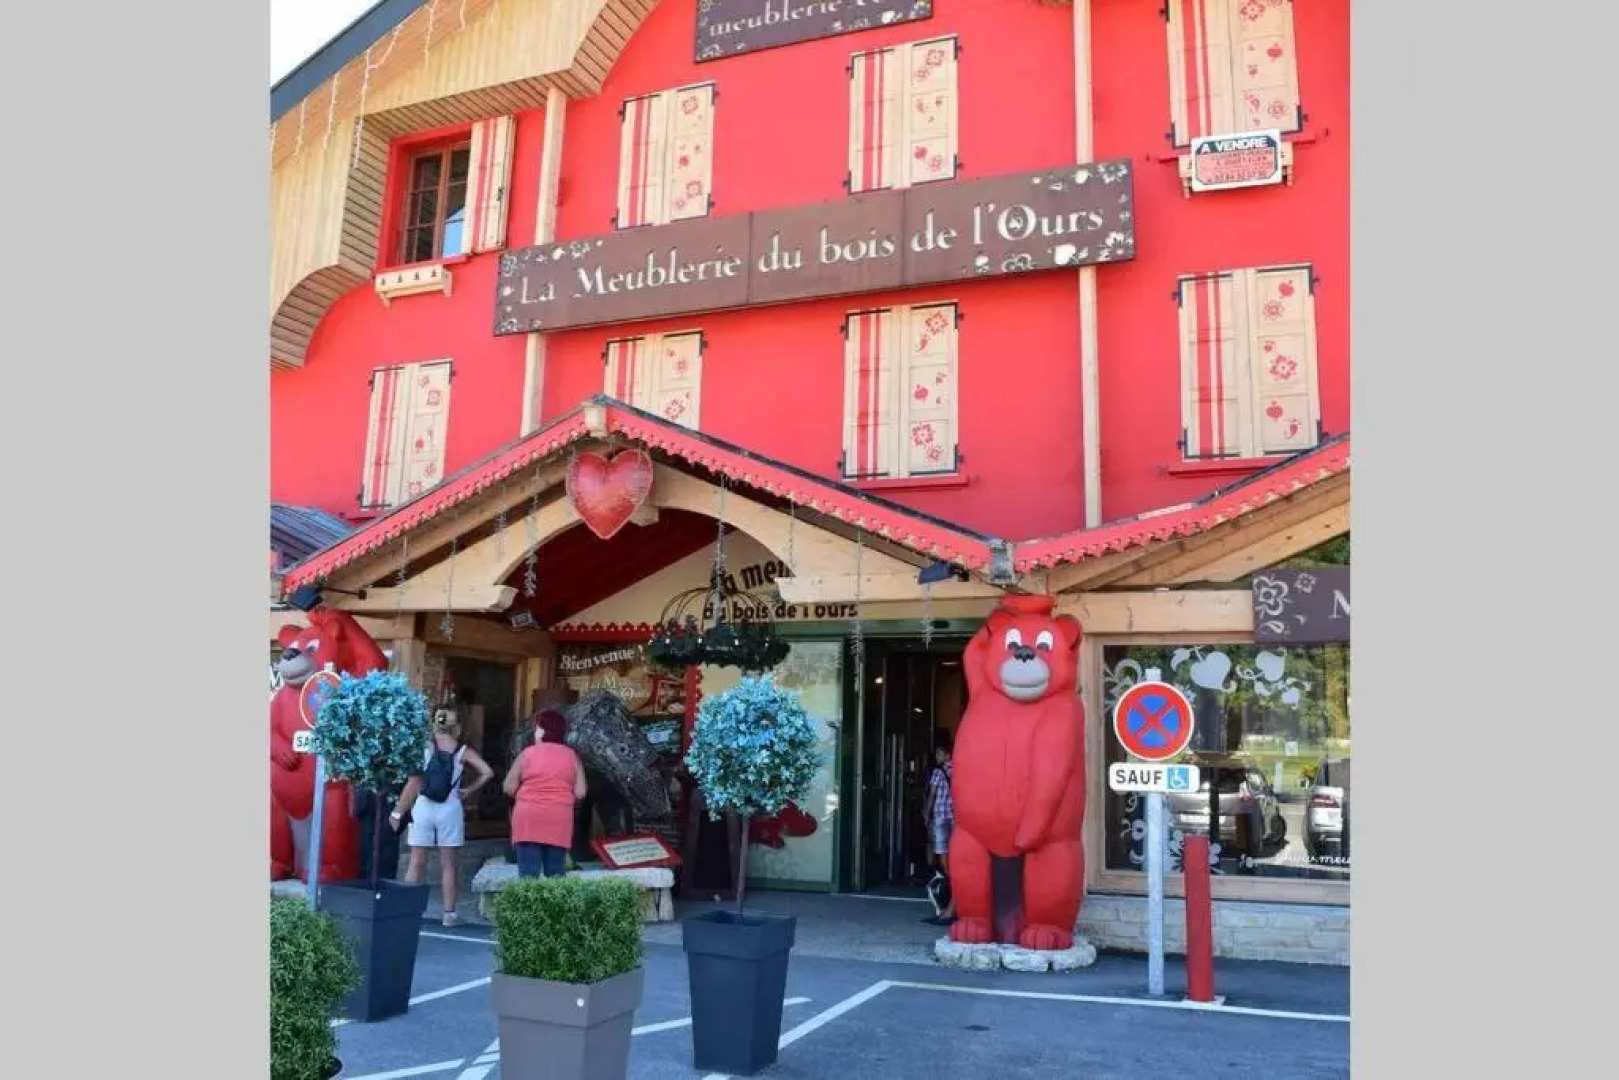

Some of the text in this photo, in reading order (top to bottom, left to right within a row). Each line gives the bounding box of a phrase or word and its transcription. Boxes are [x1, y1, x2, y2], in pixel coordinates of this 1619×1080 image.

[1201, 138, 1268, 154] A VENDRE
[520, 202, 1104, 304] La Meublerie du bois de l'Ours
[732, 602, 770, 619] bois
[774, 603, 798, 619] de
[560, 648, 635, 670] Bienvenue
[1115, 769, 1163, 785] SAUF
